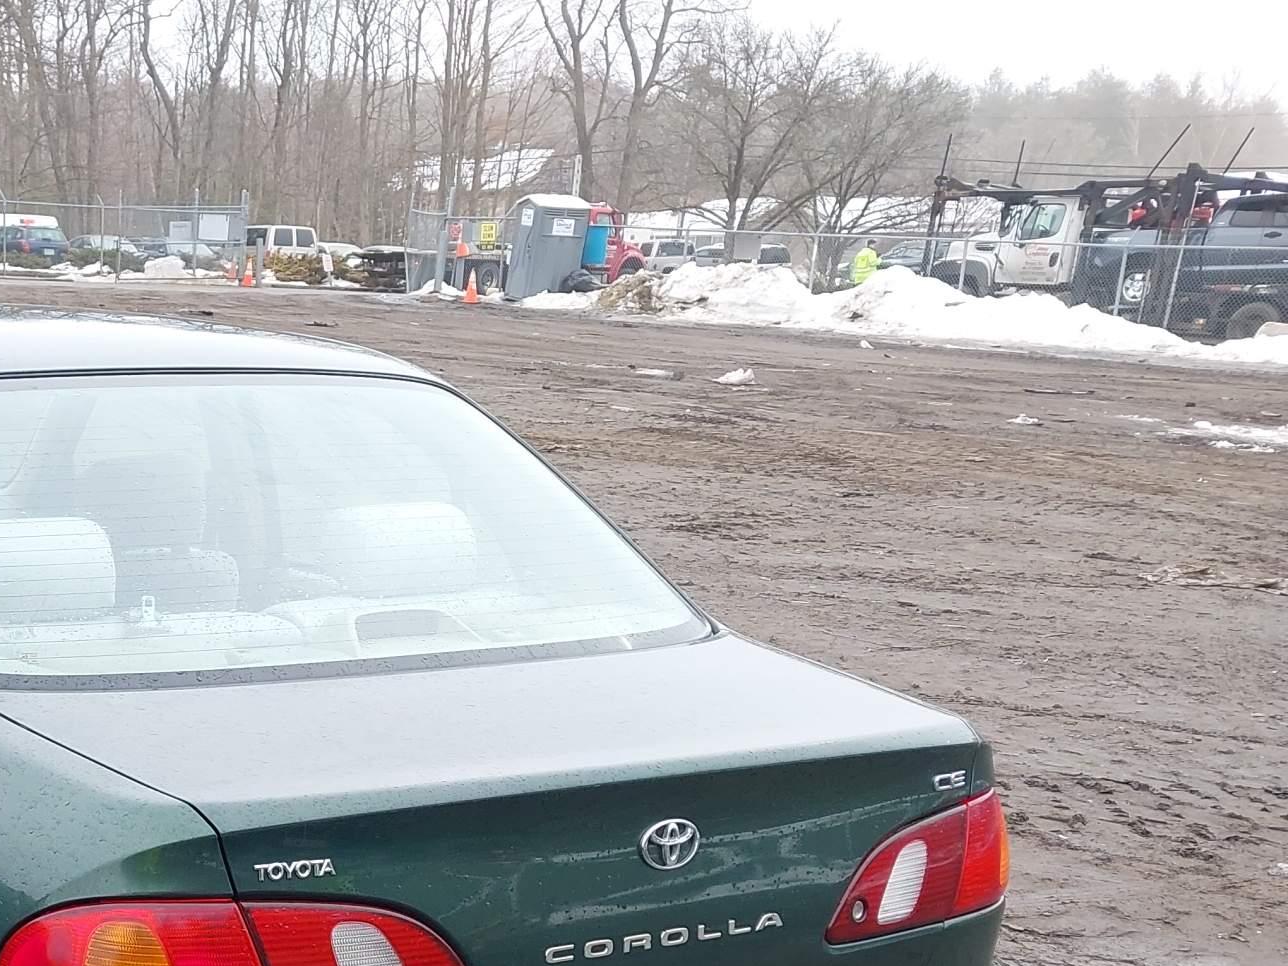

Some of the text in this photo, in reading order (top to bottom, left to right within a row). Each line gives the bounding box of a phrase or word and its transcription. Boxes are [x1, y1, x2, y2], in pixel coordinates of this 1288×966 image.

[934, 770, 966, 791] CE
[253, 858, 337, 881] TOYOTA
[545, 912, 783, 964] COROLLA
